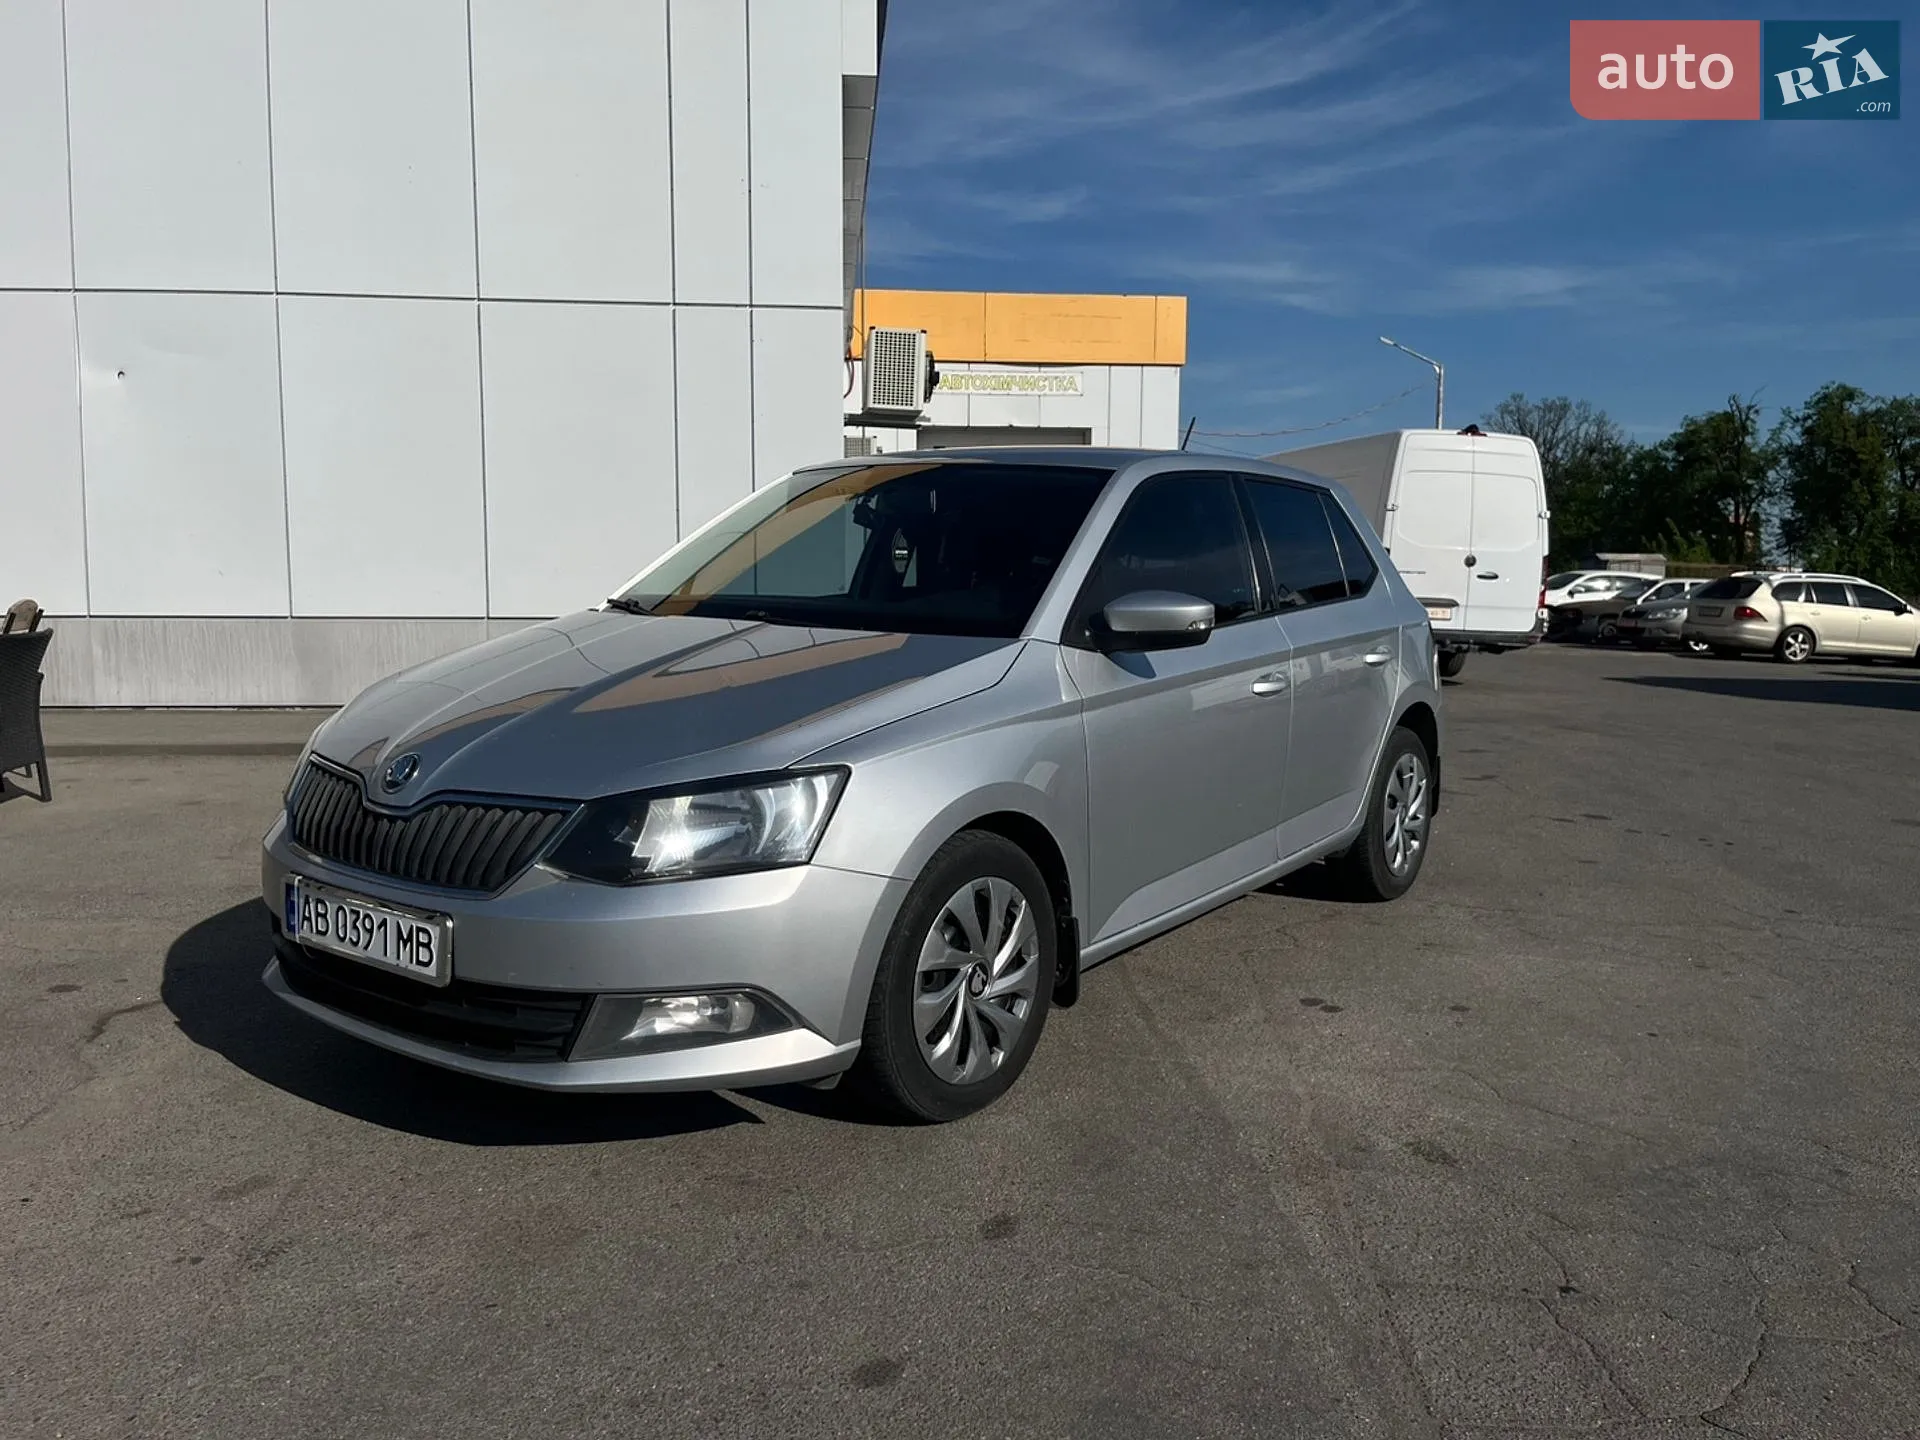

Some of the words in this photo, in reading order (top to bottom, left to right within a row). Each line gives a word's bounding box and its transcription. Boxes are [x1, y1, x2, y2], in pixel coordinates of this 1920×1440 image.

[939, 373, 1078, 392] АВТОХІМЧИСТКА
[301, 894, 331, 936] AB
[335, 905, 389, 957] 0391
[396, 920, 436, 968] MB
